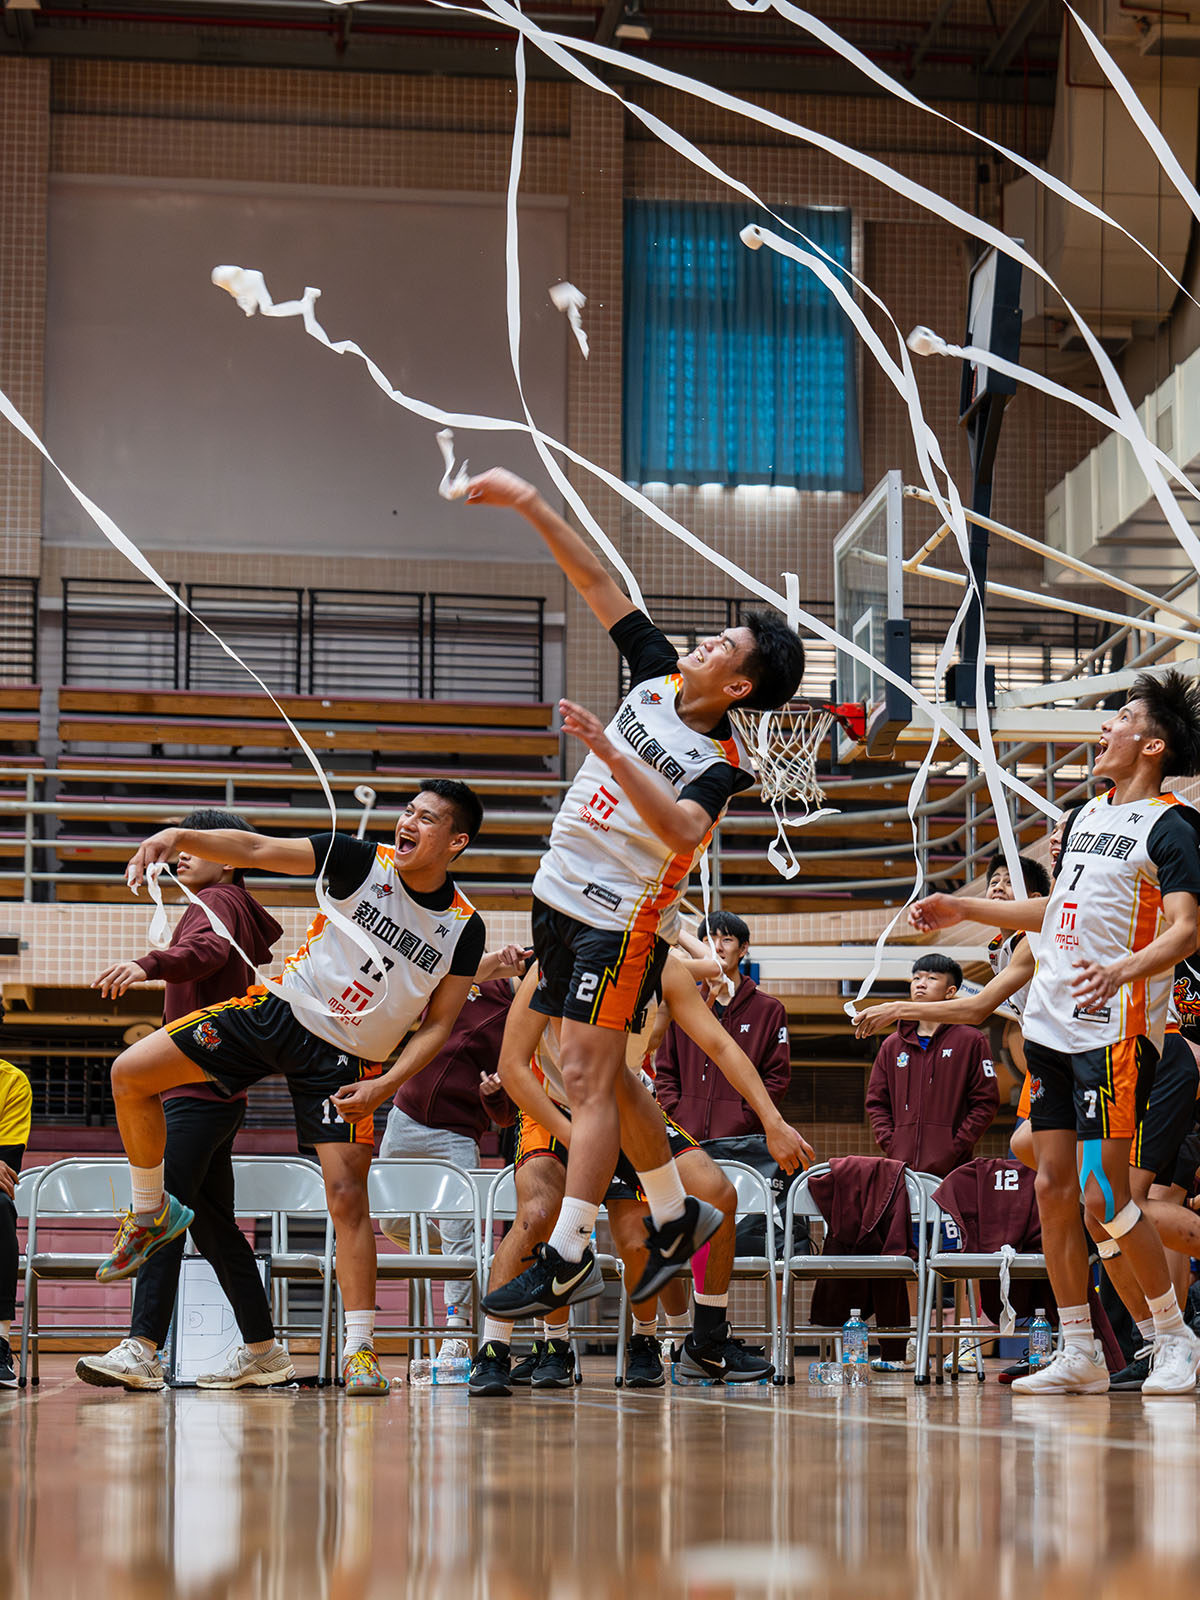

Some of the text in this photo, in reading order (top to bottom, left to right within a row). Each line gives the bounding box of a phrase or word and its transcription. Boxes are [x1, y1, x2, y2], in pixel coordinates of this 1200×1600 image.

[1069, 864, 1085, 891] 7
[352, 900, 443, 975] 熱血鳳凰
[360, 956, 395, 982] 17
[576, 972, 599, 1003] 2
[1084, 1090, 1098, 1118] 7
[994, 1169, 1019, 1190] 12
